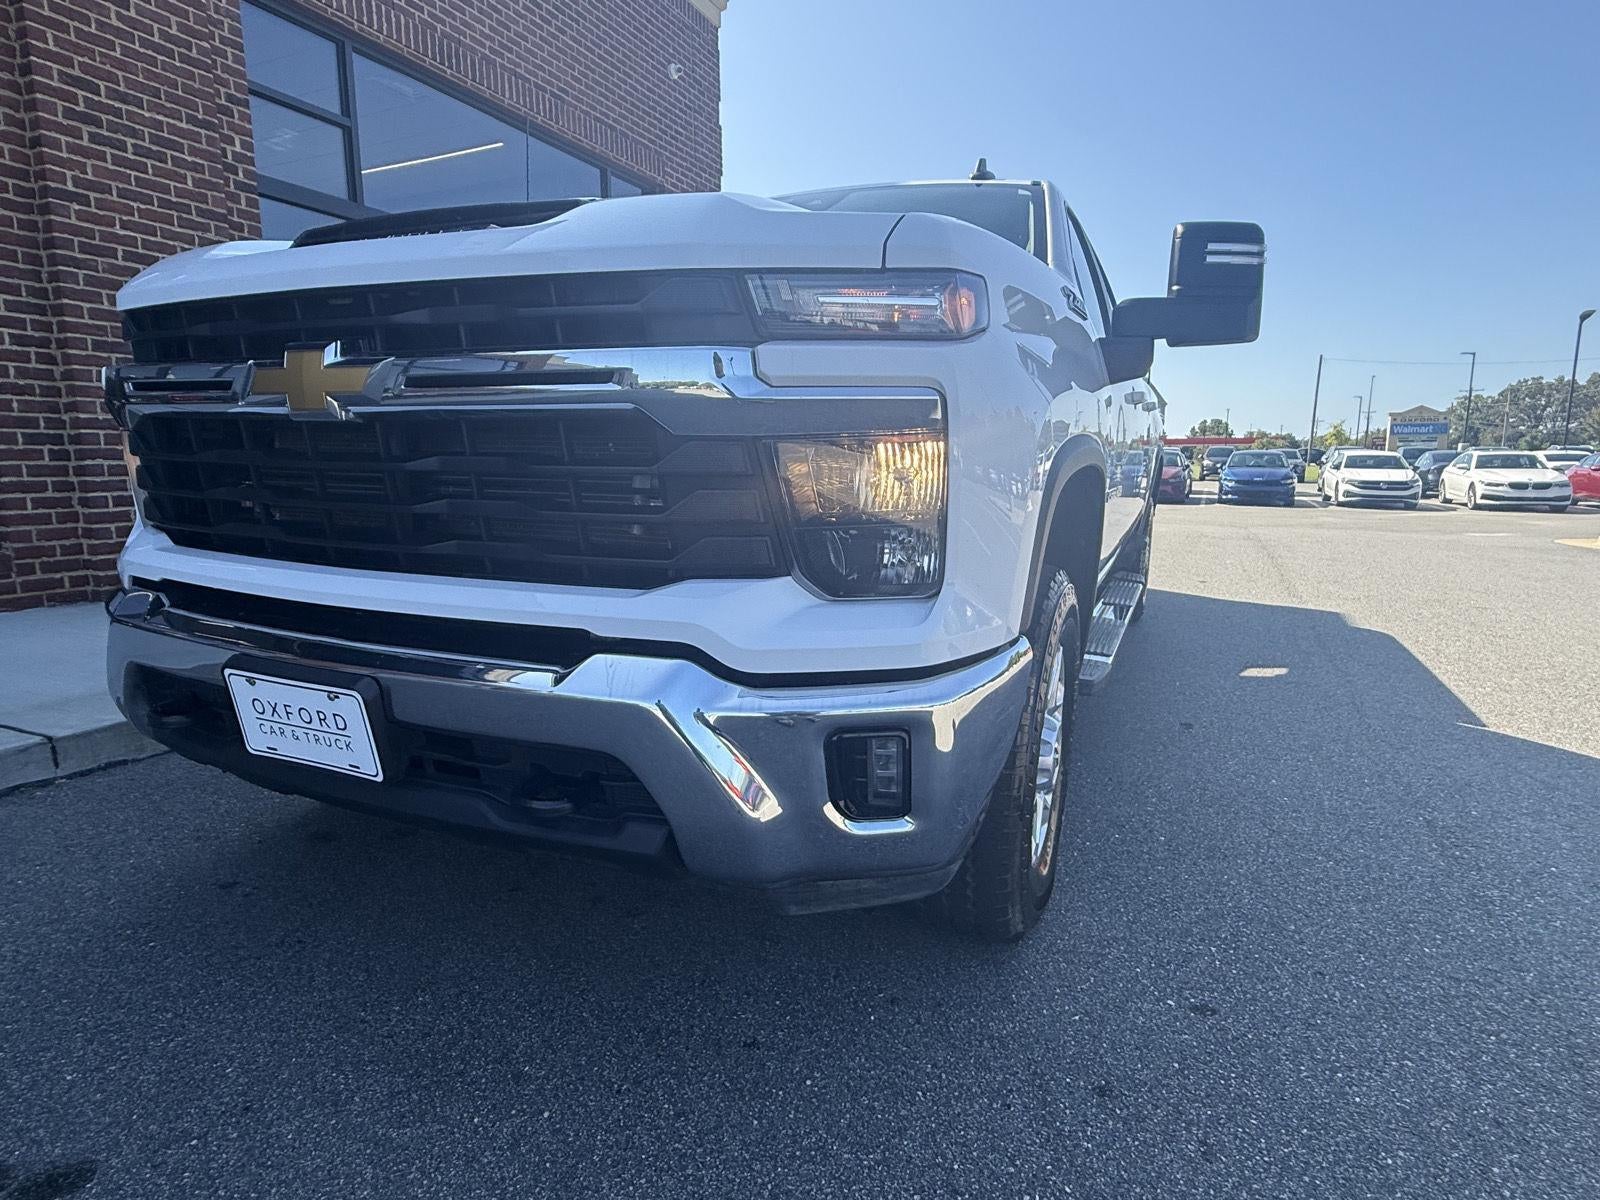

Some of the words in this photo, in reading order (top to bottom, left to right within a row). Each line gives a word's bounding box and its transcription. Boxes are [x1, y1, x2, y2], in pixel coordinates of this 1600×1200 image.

[1393, 425, 1433, 434] Walmart
[252, 698, 347, 731] OXFORD
[259, 723, 288, 738] CAR
[291, 729, 301, 741] &
[303, 732, 354, 752] TRUCK
